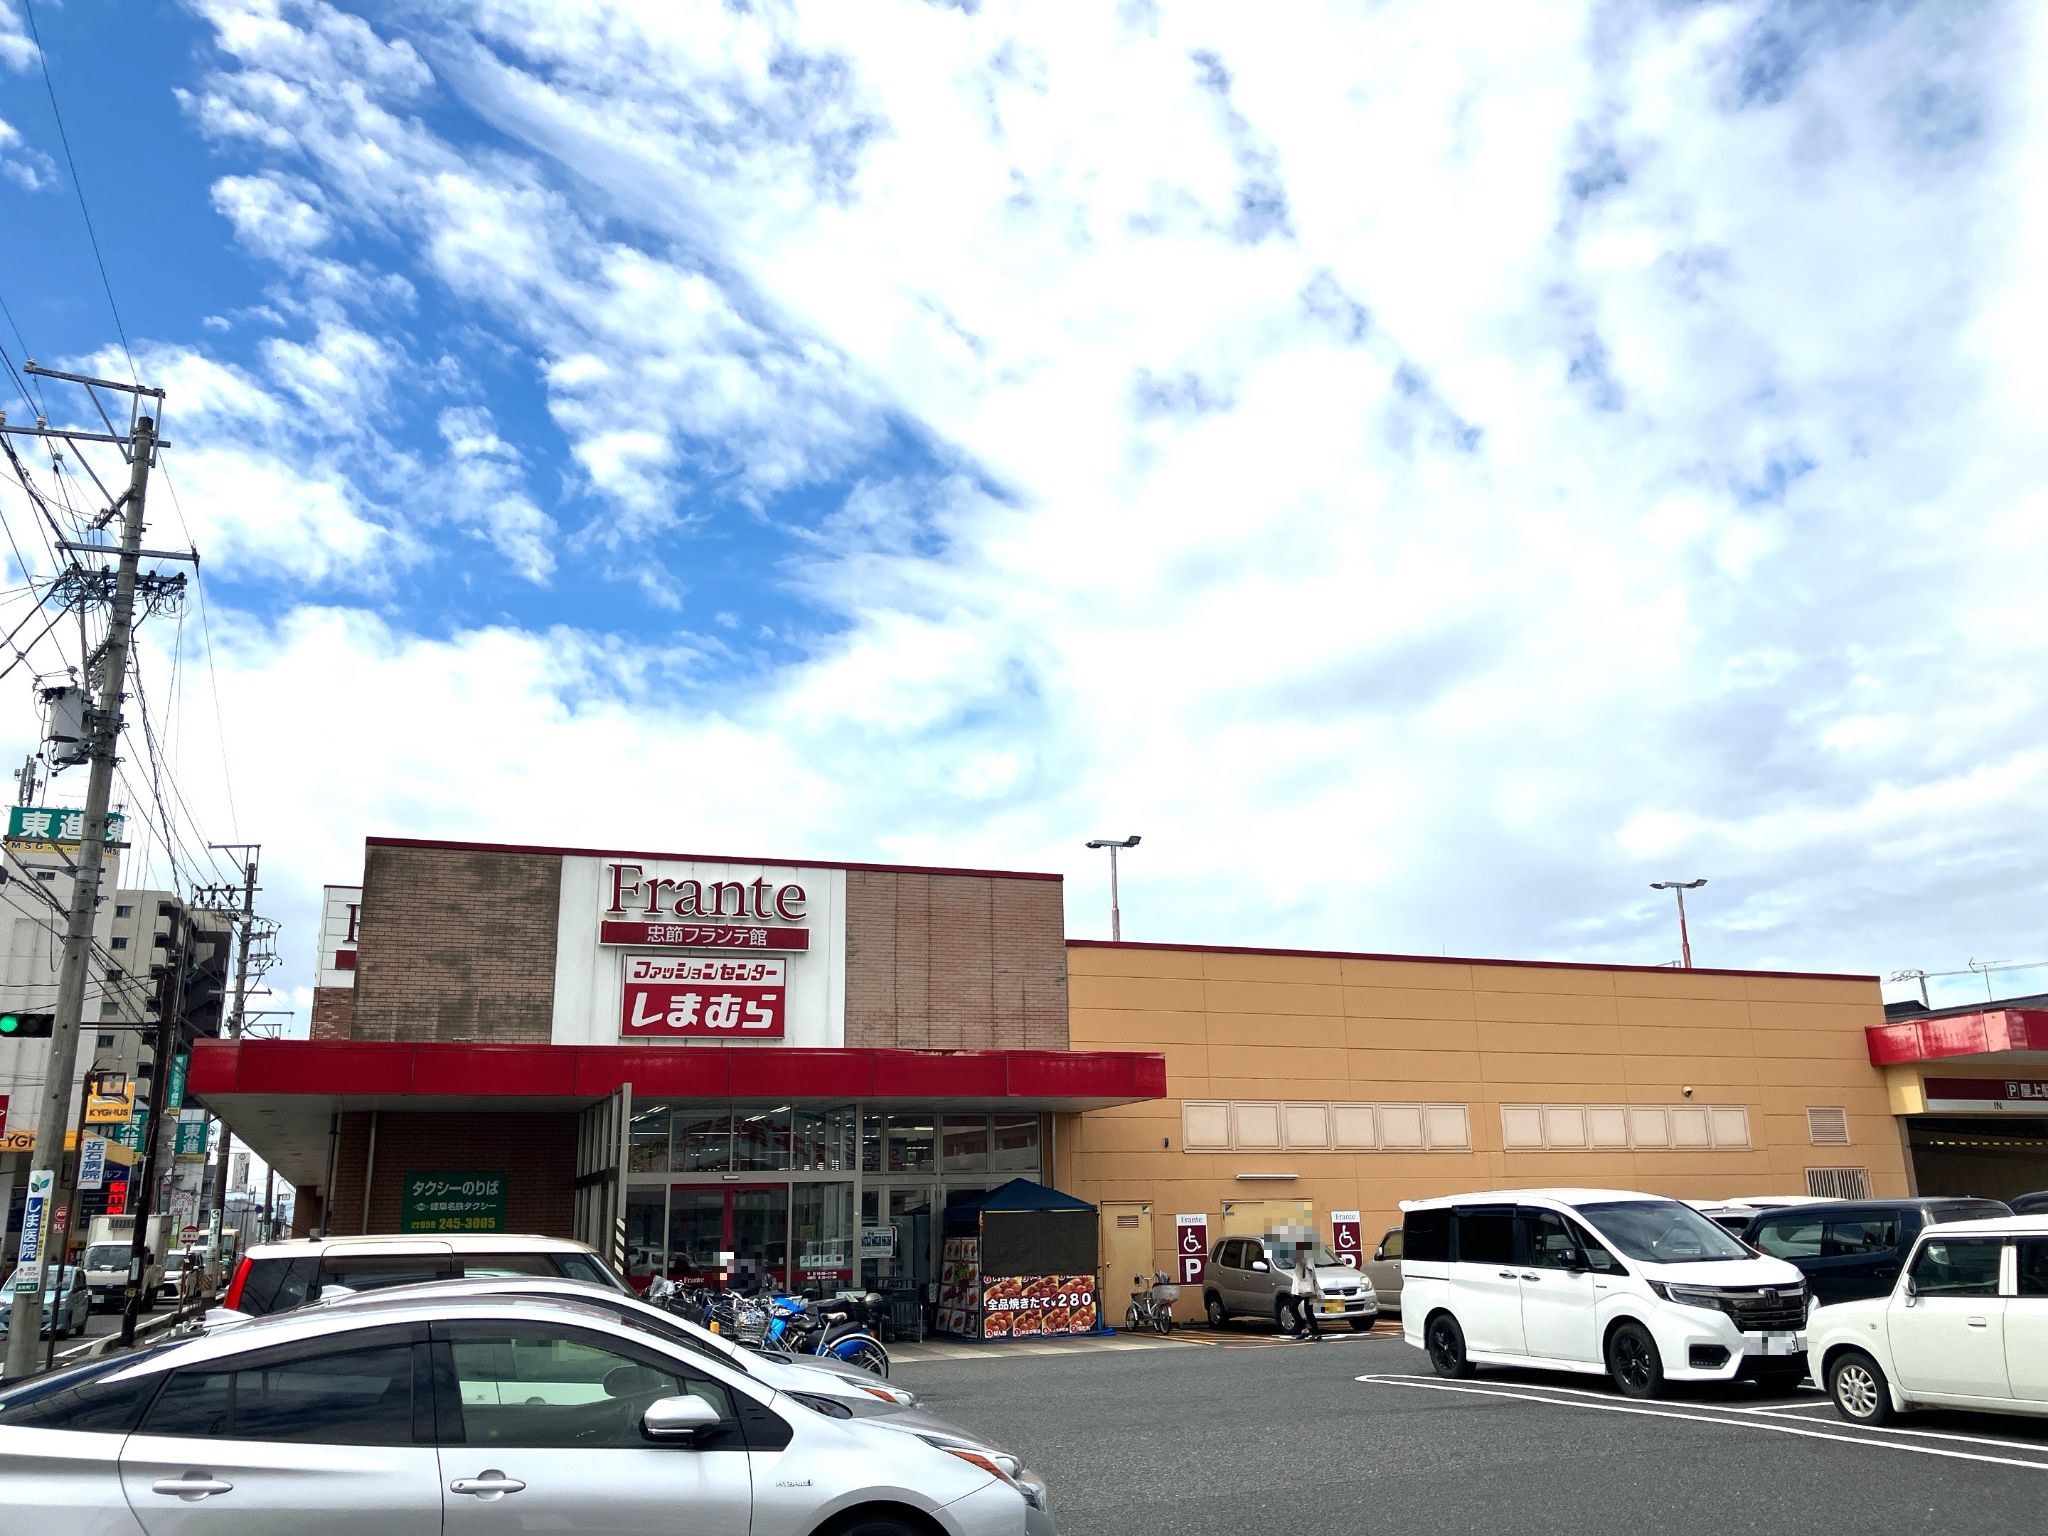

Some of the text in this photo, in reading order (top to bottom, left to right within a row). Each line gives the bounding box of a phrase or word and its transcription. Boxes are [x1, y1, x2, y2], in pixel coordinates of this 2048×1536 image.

[11, 842, 43, 850] MSG
[606, 864, 808, 920] Frante
[646, 925, 768, 947] 忠節フランテ館
[633, 961, 778, 981] ファッションセンター
[631, 991, 777, 1029] しまむら
[1993, 1102, 2003, 1110] IN
[181, 1123, 201, 1154] 東進
[81, 1141, 105, 1180] 近石病院
[104, 1170, 122, 1179] ルフ
[412, 1180, 500, 1196] タクシーのりば
[439, 1217, 496, 1230] 245-3005
[1181, 1216, 1203, 1224] Frante
[1335, 1213, 1356, 1221] Frante
[21, 1199, 42, 1259] しま医院
[1185, 1258, 1202, 1283] P
[683, 1276, 705, 1284] Frante
